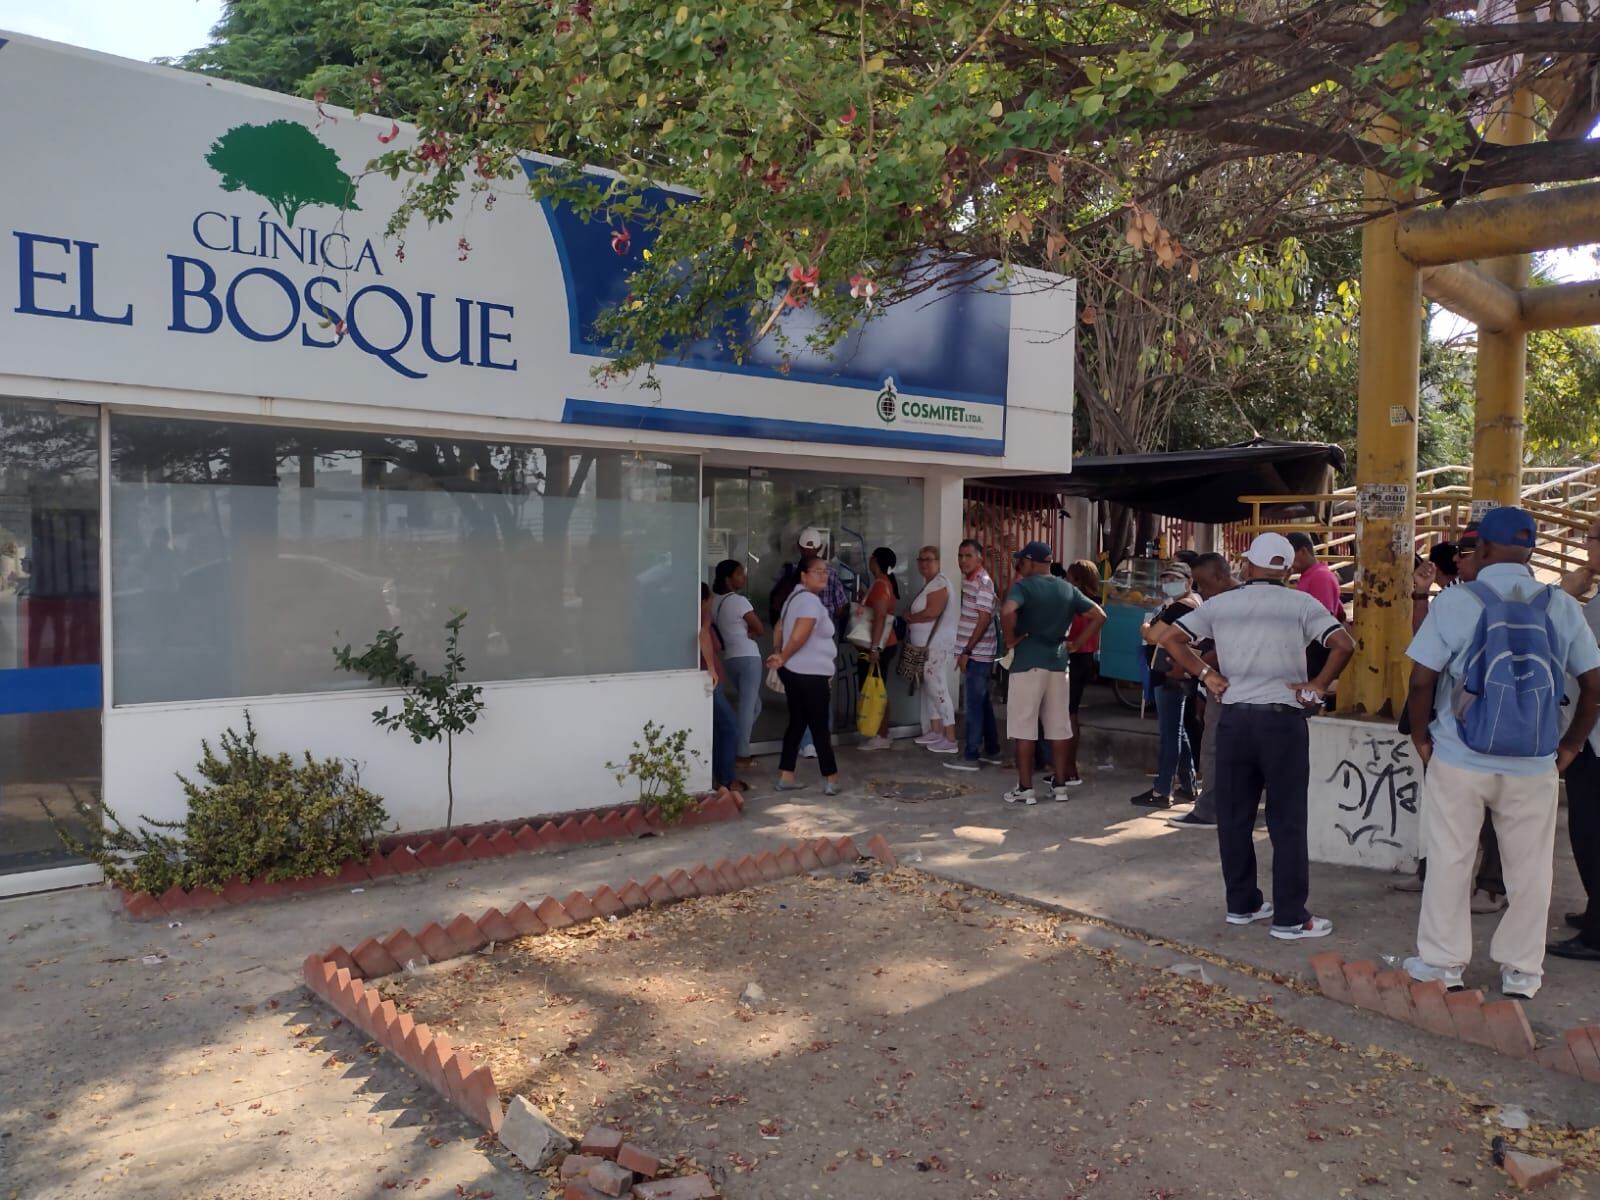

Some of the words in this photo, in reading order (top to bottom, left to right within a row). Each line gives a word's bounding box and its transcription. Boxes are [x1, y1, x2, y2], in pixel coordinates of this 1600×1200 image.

[193, 211, 384, 276] CLÍNICA
[13, 231, 133, 326] EL
[167, 254, 518, 379] BOSQUE
[902, 402, 965, 422] COSMITET
